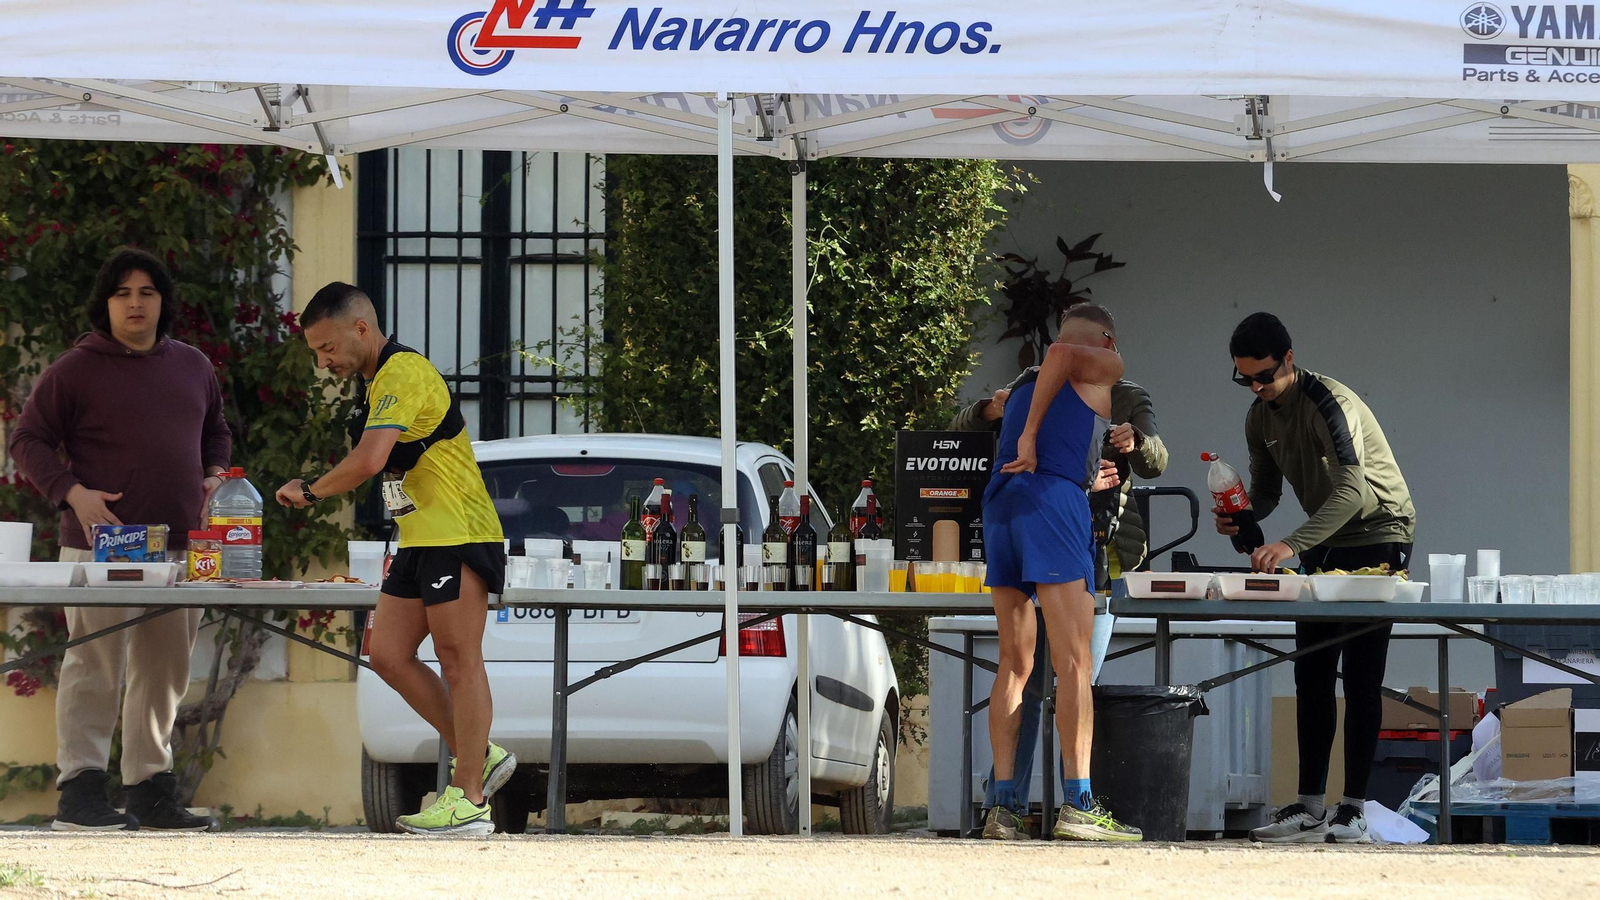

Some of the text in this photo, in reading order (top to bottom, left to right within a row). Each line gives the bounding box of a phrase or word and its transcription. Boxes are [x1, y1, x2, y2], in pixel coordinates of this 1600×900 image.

[1510, 4, 1600, 40] YAM
[607, 7, 1002, 55] Navarro Hnos.
[1505, 46, 1600, 66] GENUI
[1462, 67, 1519, 82] Parts
[1525, 69, 1540, 83] &
[933, 440, 960, 450] HSN
[905, 457, 988, 471] EVOTONIC
[195, 558, 216, 571] Krit
